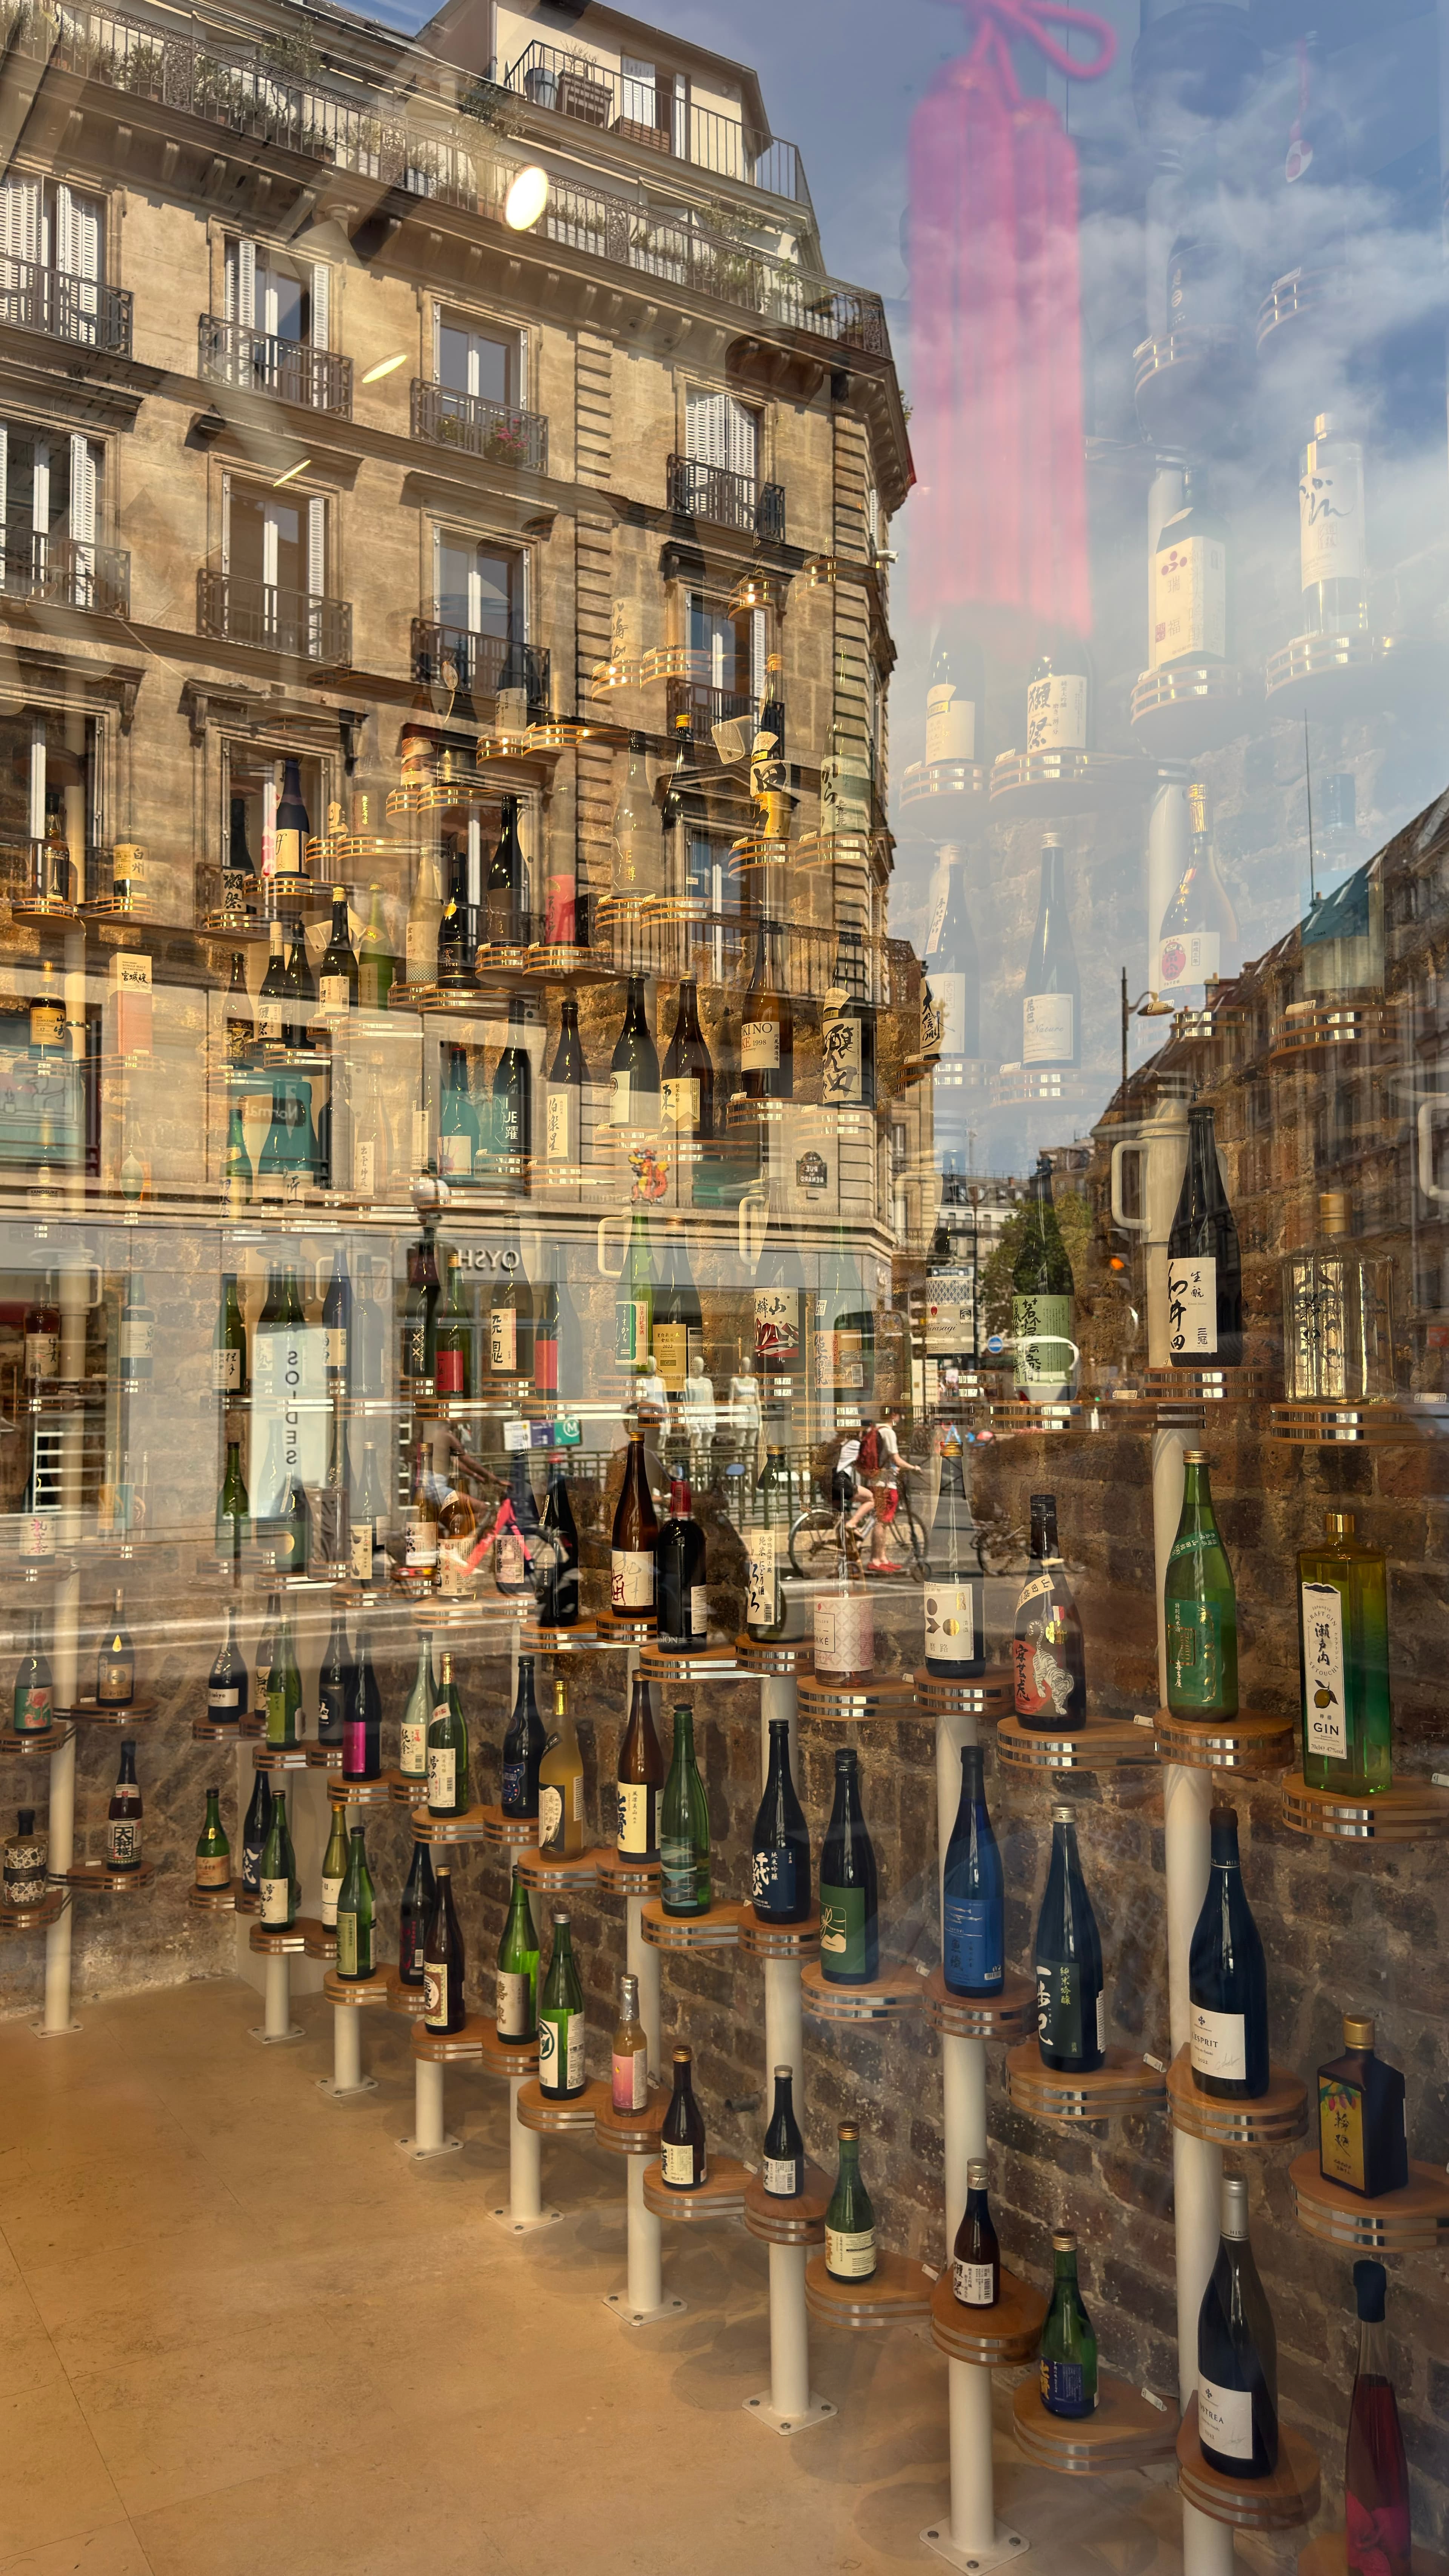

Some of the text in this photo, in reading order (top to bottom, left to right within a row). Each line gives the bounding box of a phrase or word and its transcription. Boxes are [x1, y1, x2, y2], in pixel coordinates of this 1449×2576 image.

[132, 848, 146, 877] 白州
[753, 1023, 773, 1034] NO
[505, 1126, 518, 1139] 躍
[1197, 1327, 1208, 1345] 三冠
[1307, 1613, 1337, 1627] CRAFT GIN
[1314, 1622, 1331, 1666] 瀬戸内
[1016, 1644, 1031, 1701] 安芸虎
[1309, 1661, 1339, 1676] SETOUCHI
[1313, 1722, 1339, 1736] GIN
[1060, 1967, 1071, 2005] 純米吟醸
